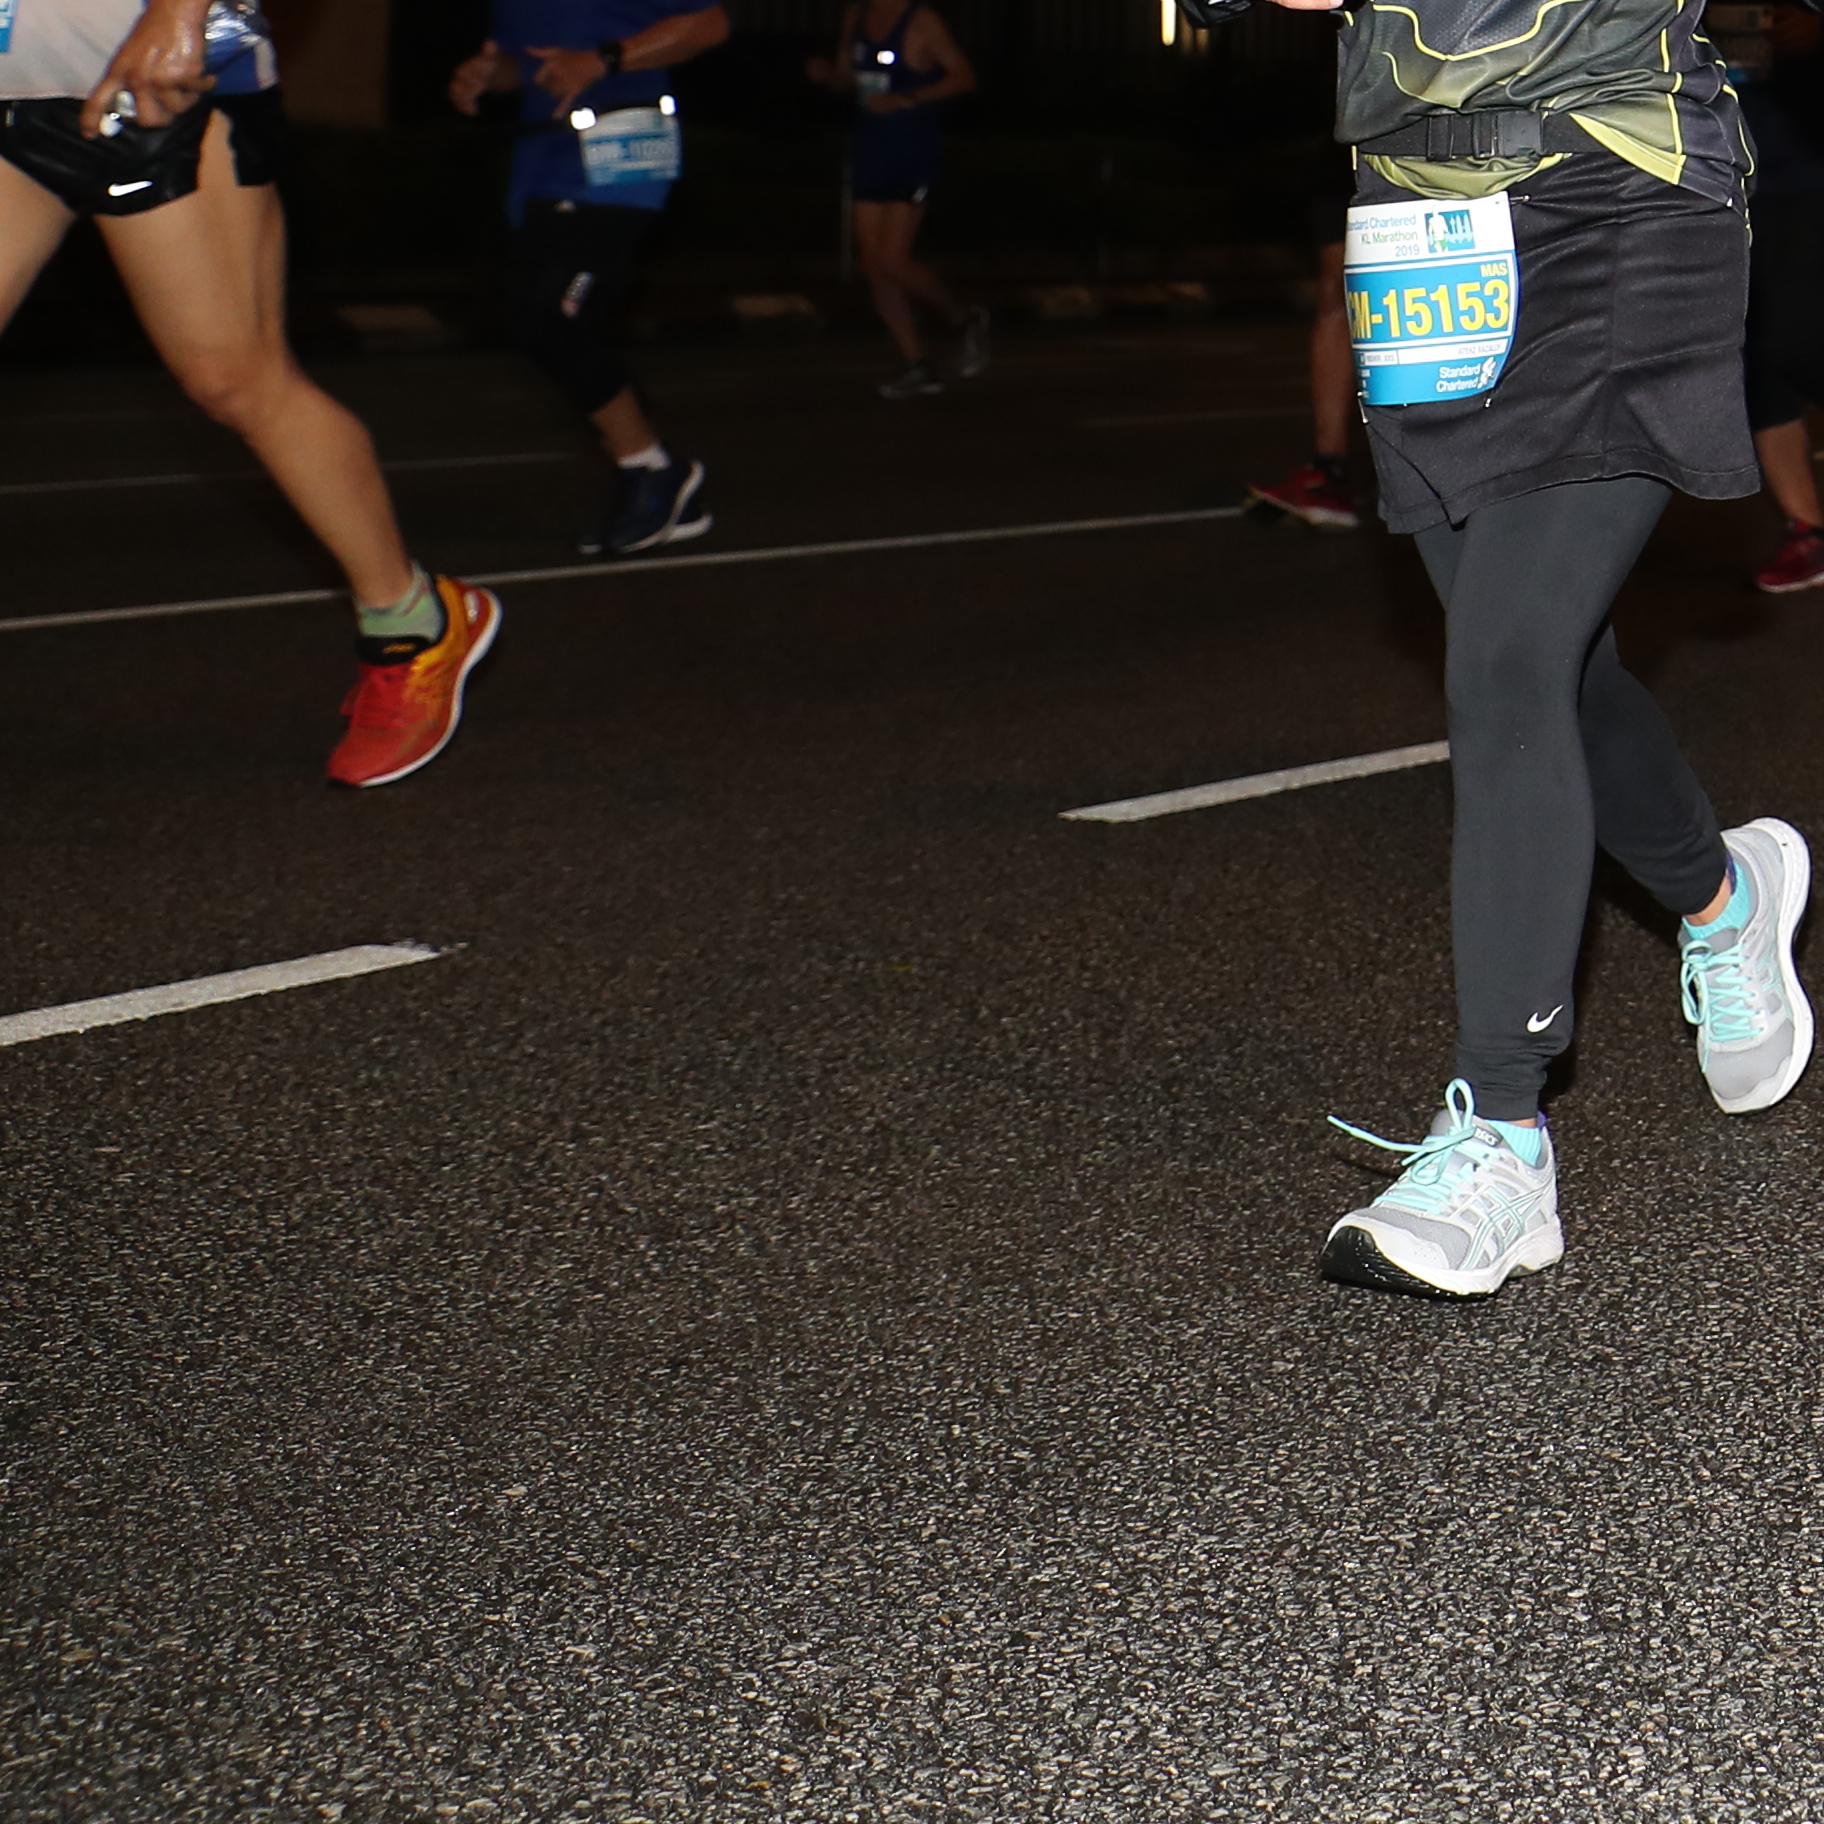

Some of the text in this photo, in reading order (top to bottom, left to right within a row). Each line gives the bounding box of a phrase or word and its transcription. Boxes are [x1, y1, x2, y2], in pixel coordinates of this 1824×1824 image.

[1369, 214, 1417, 229] Chartered
[1372, 230, 1418, 244] Marathon
[1395, 244, 1420, 257] 2019
[1480, 262, 1508, 278] MAS
[1438, 363, 1481, 379] Standard
[1435, 377, 1479, 393] Chartered
